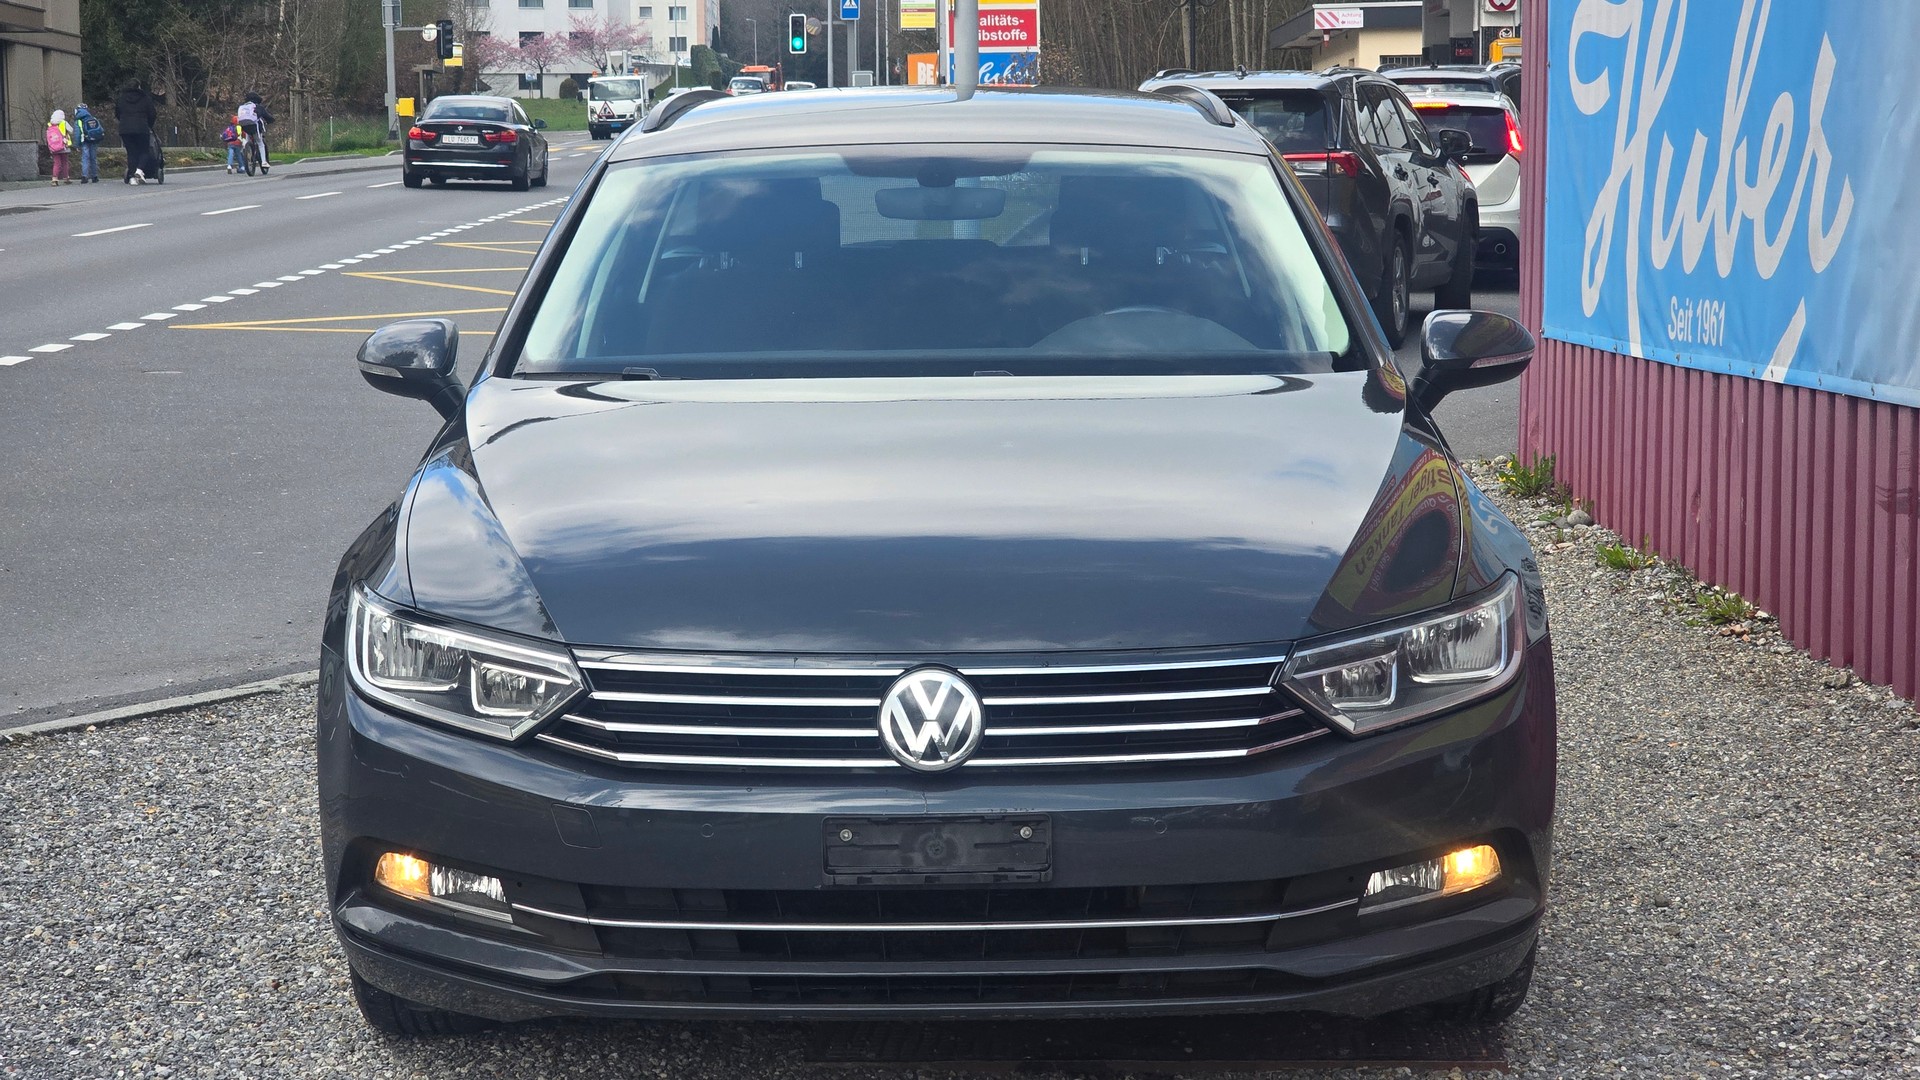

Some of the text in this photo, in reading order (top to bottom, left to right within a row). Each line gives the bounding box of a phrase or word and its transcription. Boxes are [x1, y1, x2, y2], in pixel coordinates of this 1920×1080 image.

[978, 29, 1028, 41] ibstoffe
[979, 14, 1025, 26] alitäts-
[1569, 0, 1854, 357] Huber
[1667, 295, 1726, 347] Seit 1961
